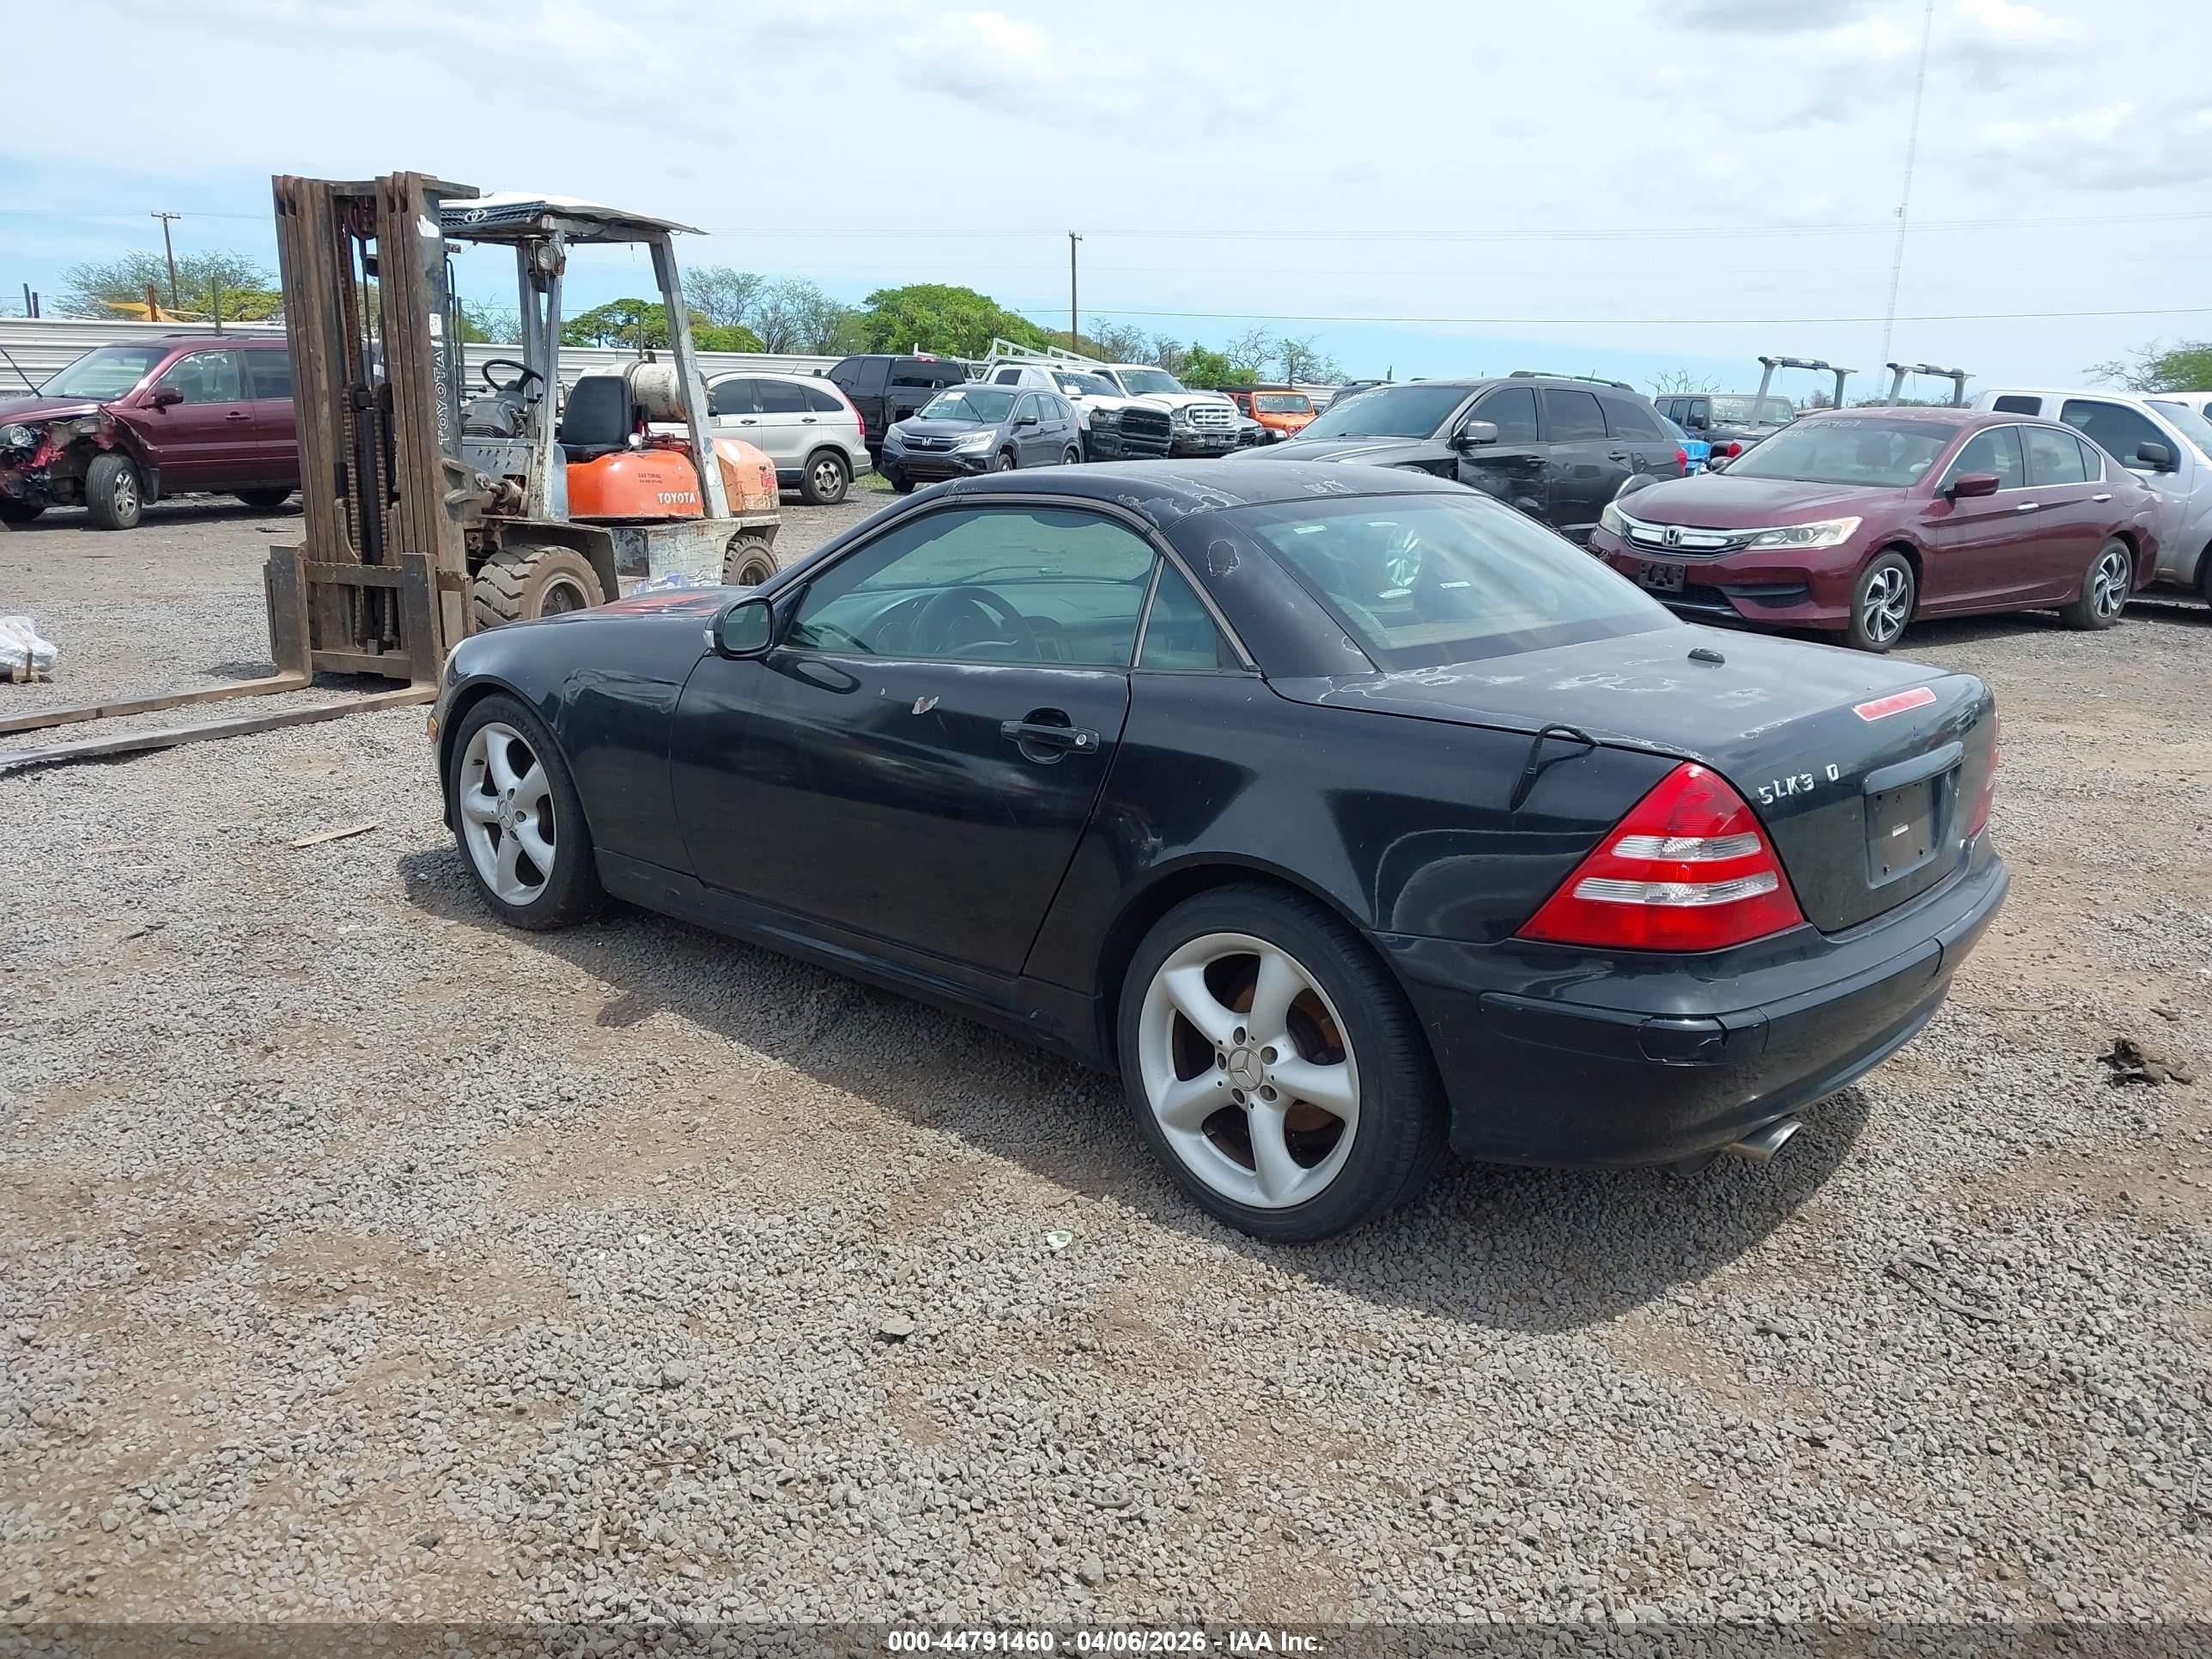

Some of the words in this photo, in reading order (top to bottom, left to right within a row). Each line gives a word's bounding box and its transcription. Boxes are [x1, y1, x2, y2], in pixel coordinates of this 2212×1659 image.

[433, 349, 450, 446] TOYOTA
[657, 491, 696, 505] TOYOTA
[1758, 772, 1815, 805] SLK3
